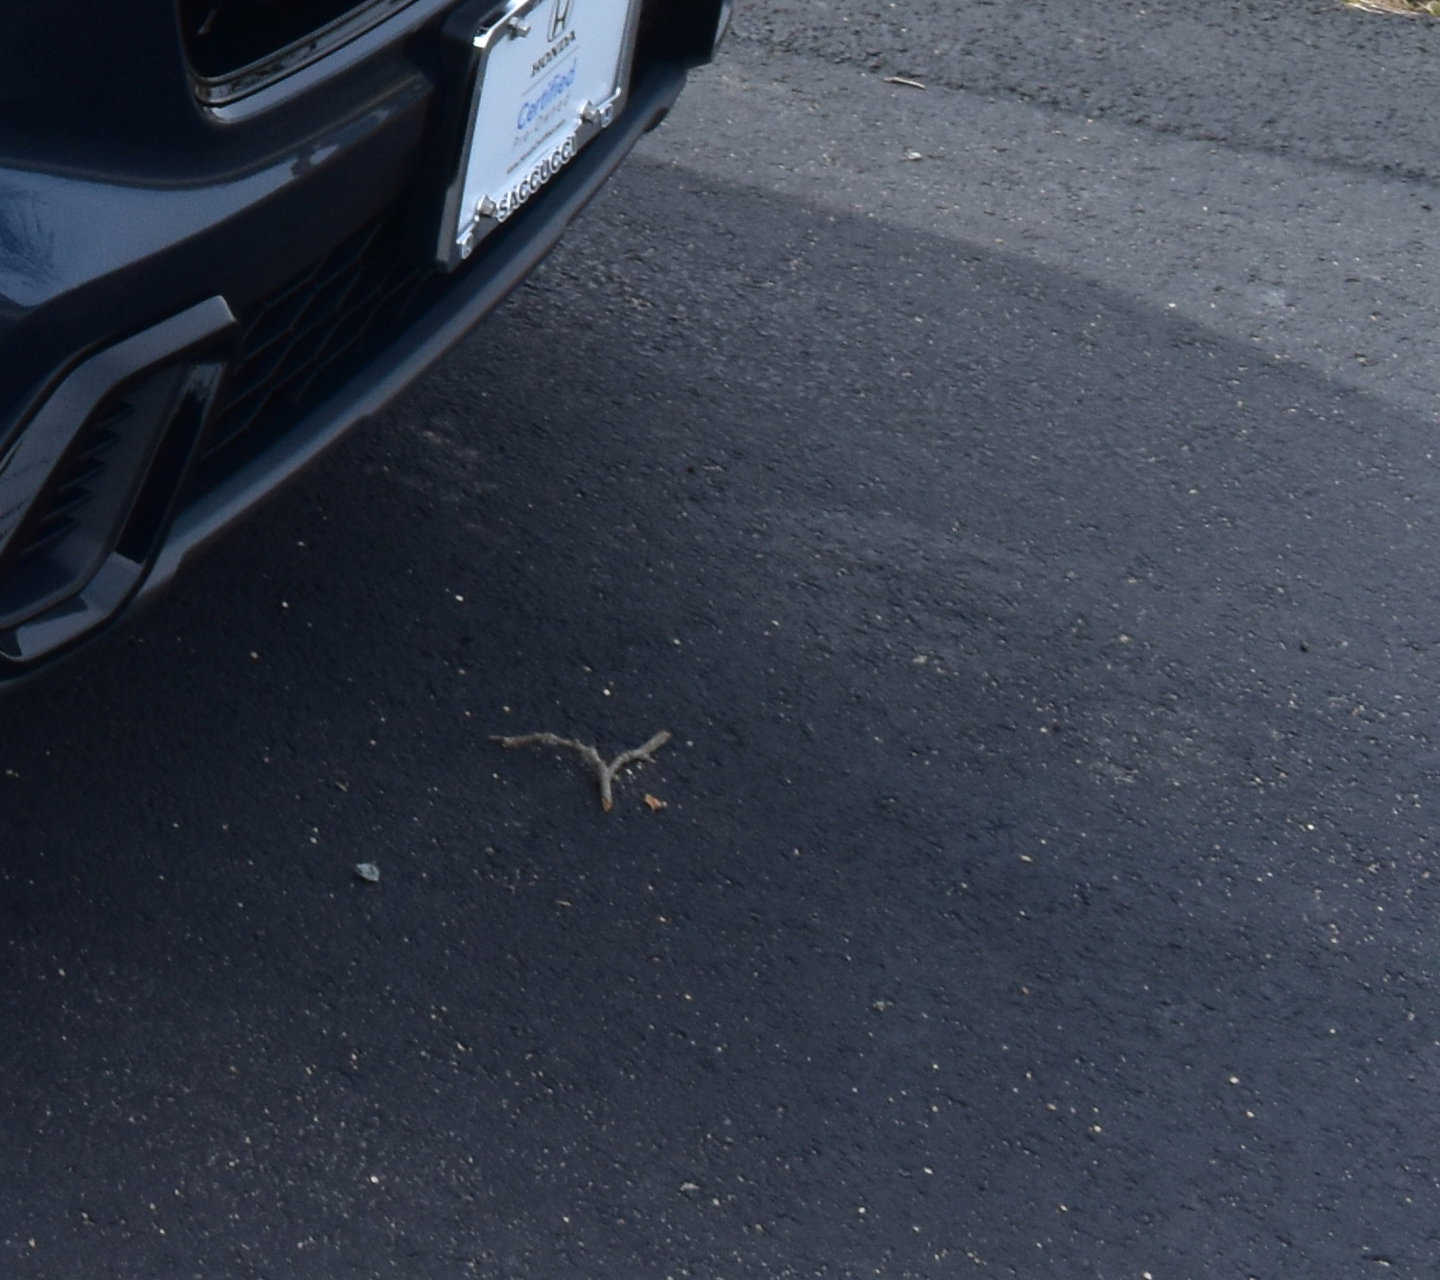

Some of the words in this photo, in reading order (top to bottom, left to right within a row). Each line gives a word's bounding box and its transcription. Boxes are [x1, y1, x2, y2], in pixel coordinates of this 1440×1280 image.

[530, 29, 576, 78] HONDA
[516, 57, 577, 130] Certified
[496, 131, 578, 223] SACCUCCI
